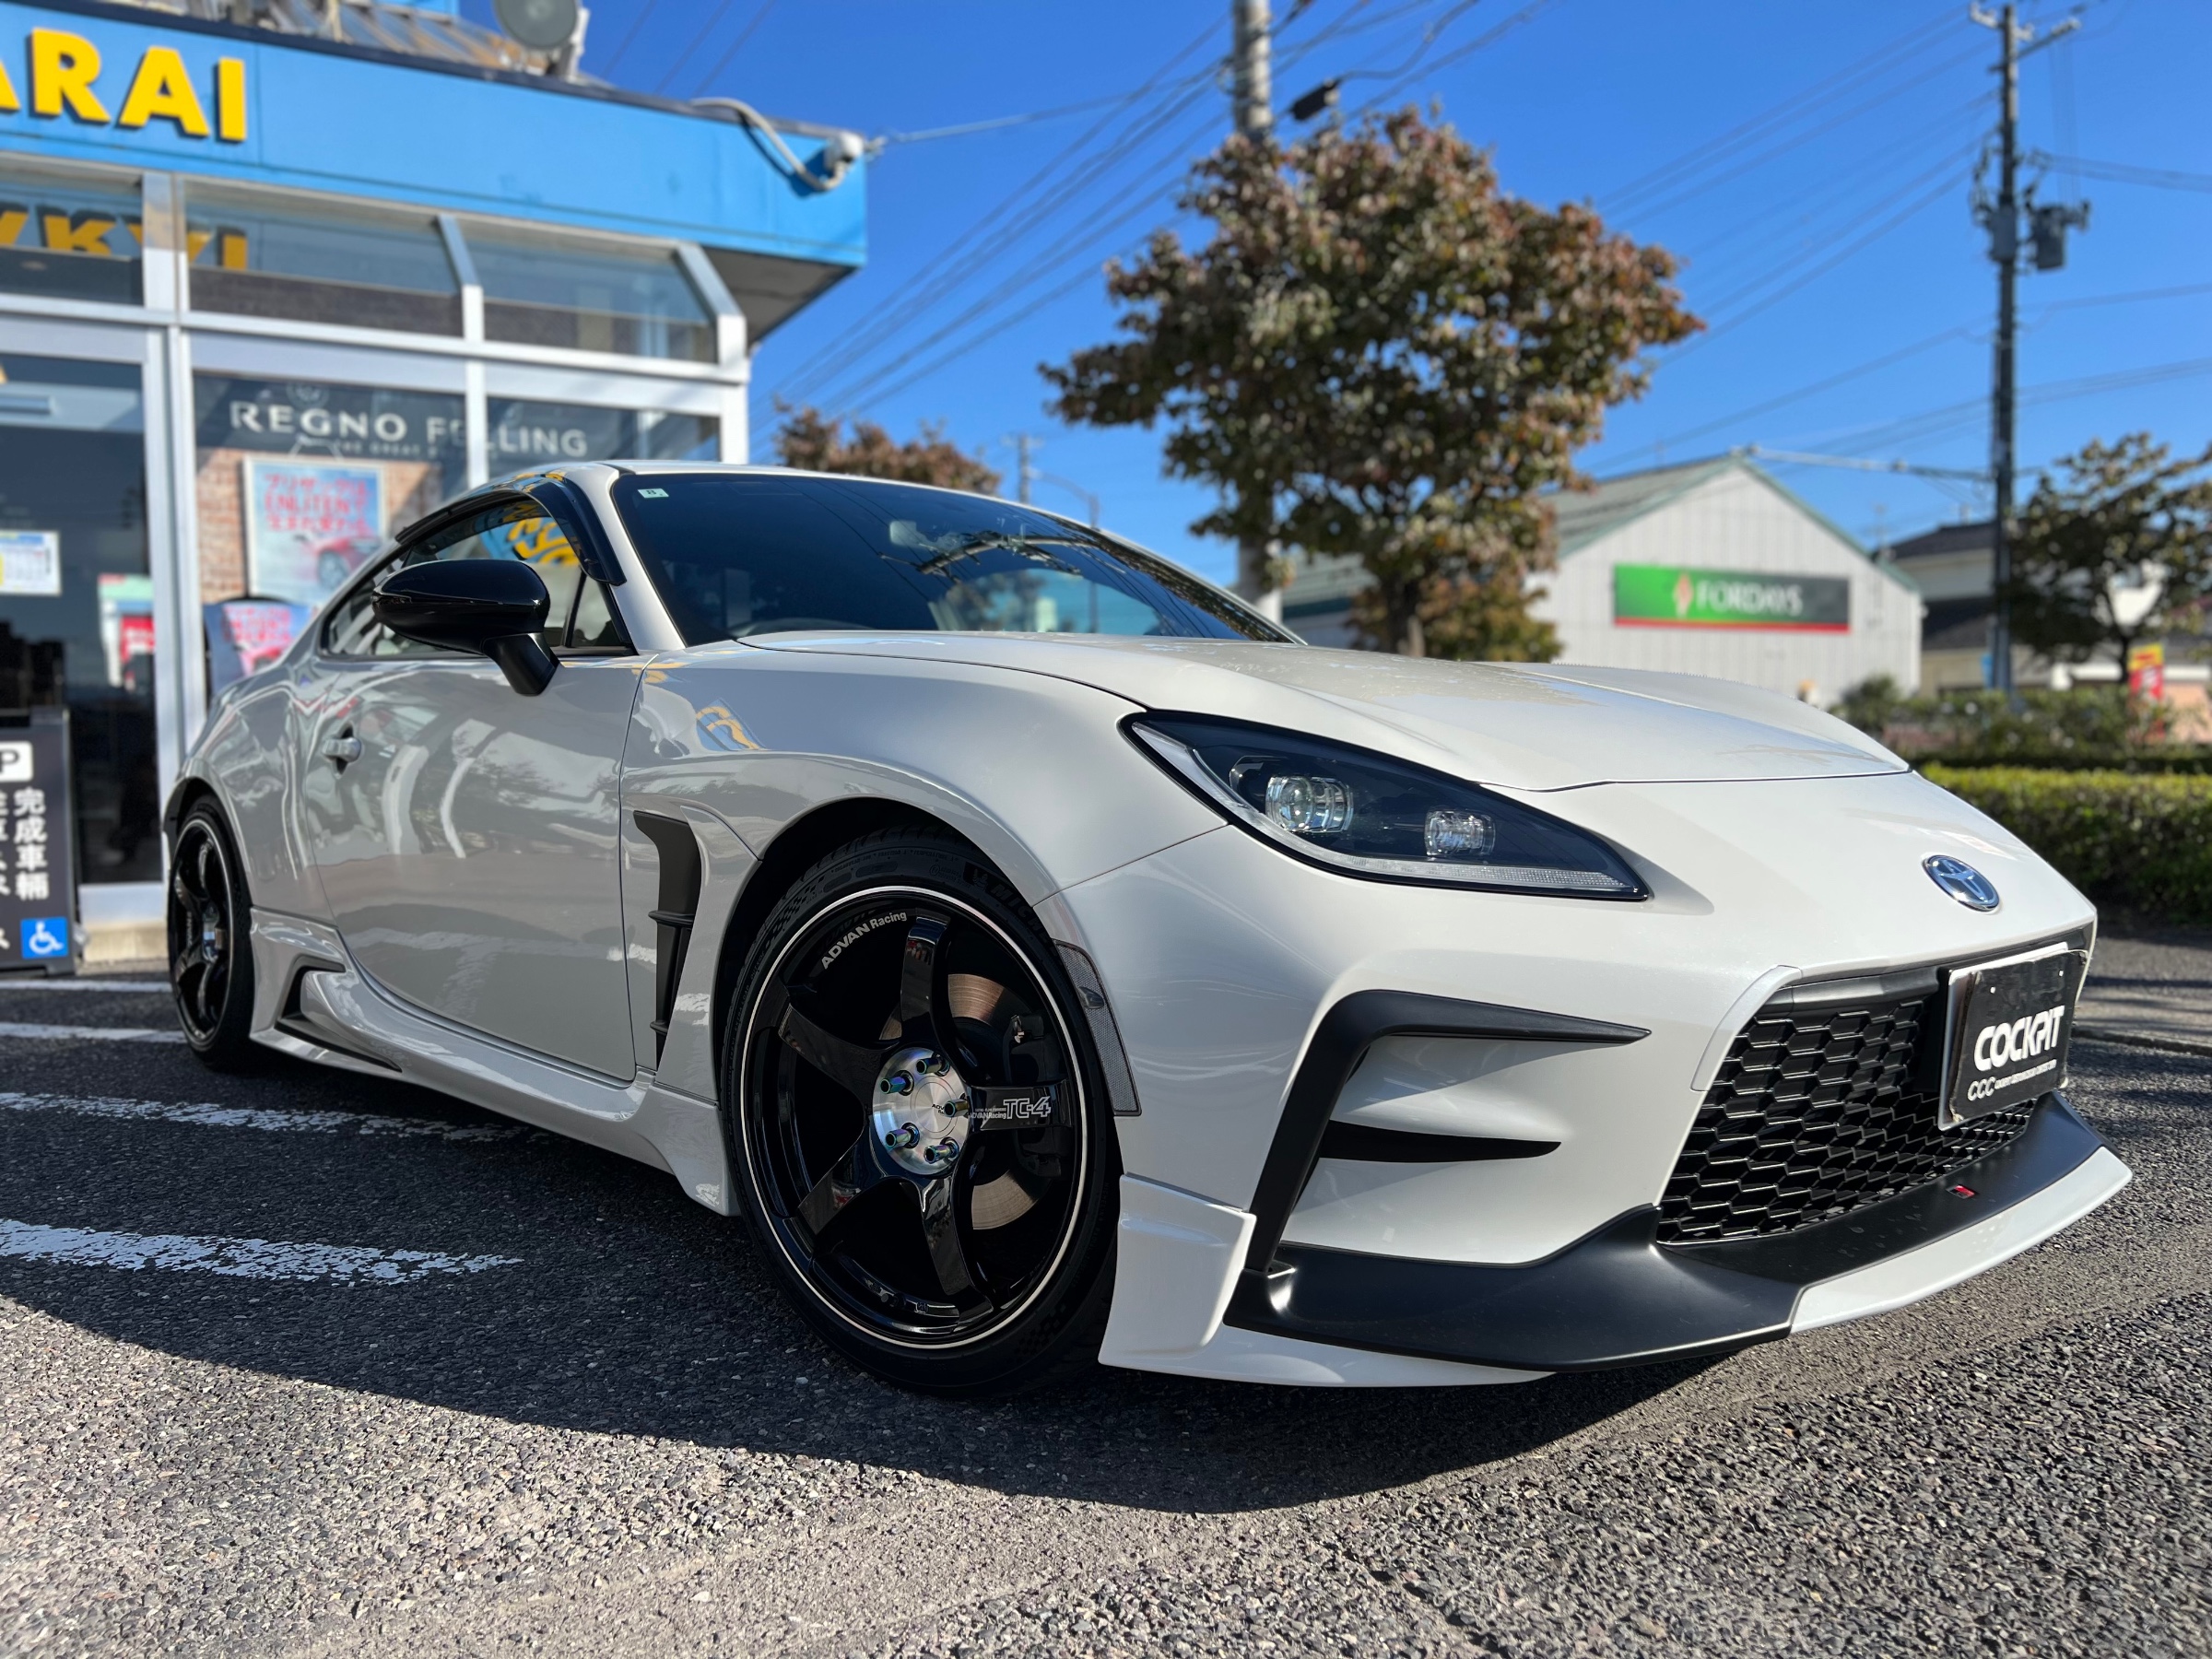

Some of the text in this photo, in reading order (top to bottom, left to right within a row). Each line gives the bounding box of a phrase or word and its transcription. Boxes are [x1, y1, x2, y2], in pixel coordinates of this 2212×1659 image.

[0, 26, 247, 141] RAI
[229, 400, 407, 442] REGNO
[426, 416, 588, 457] FELING
[821, 912, 908, 970] ADVAN Racing
[1973, 1005, 2065, 1071] COCKPIT
[1003, 1095, 1052, 1120] TC-4
[1967, 1076, 1997, 1101] CCC
